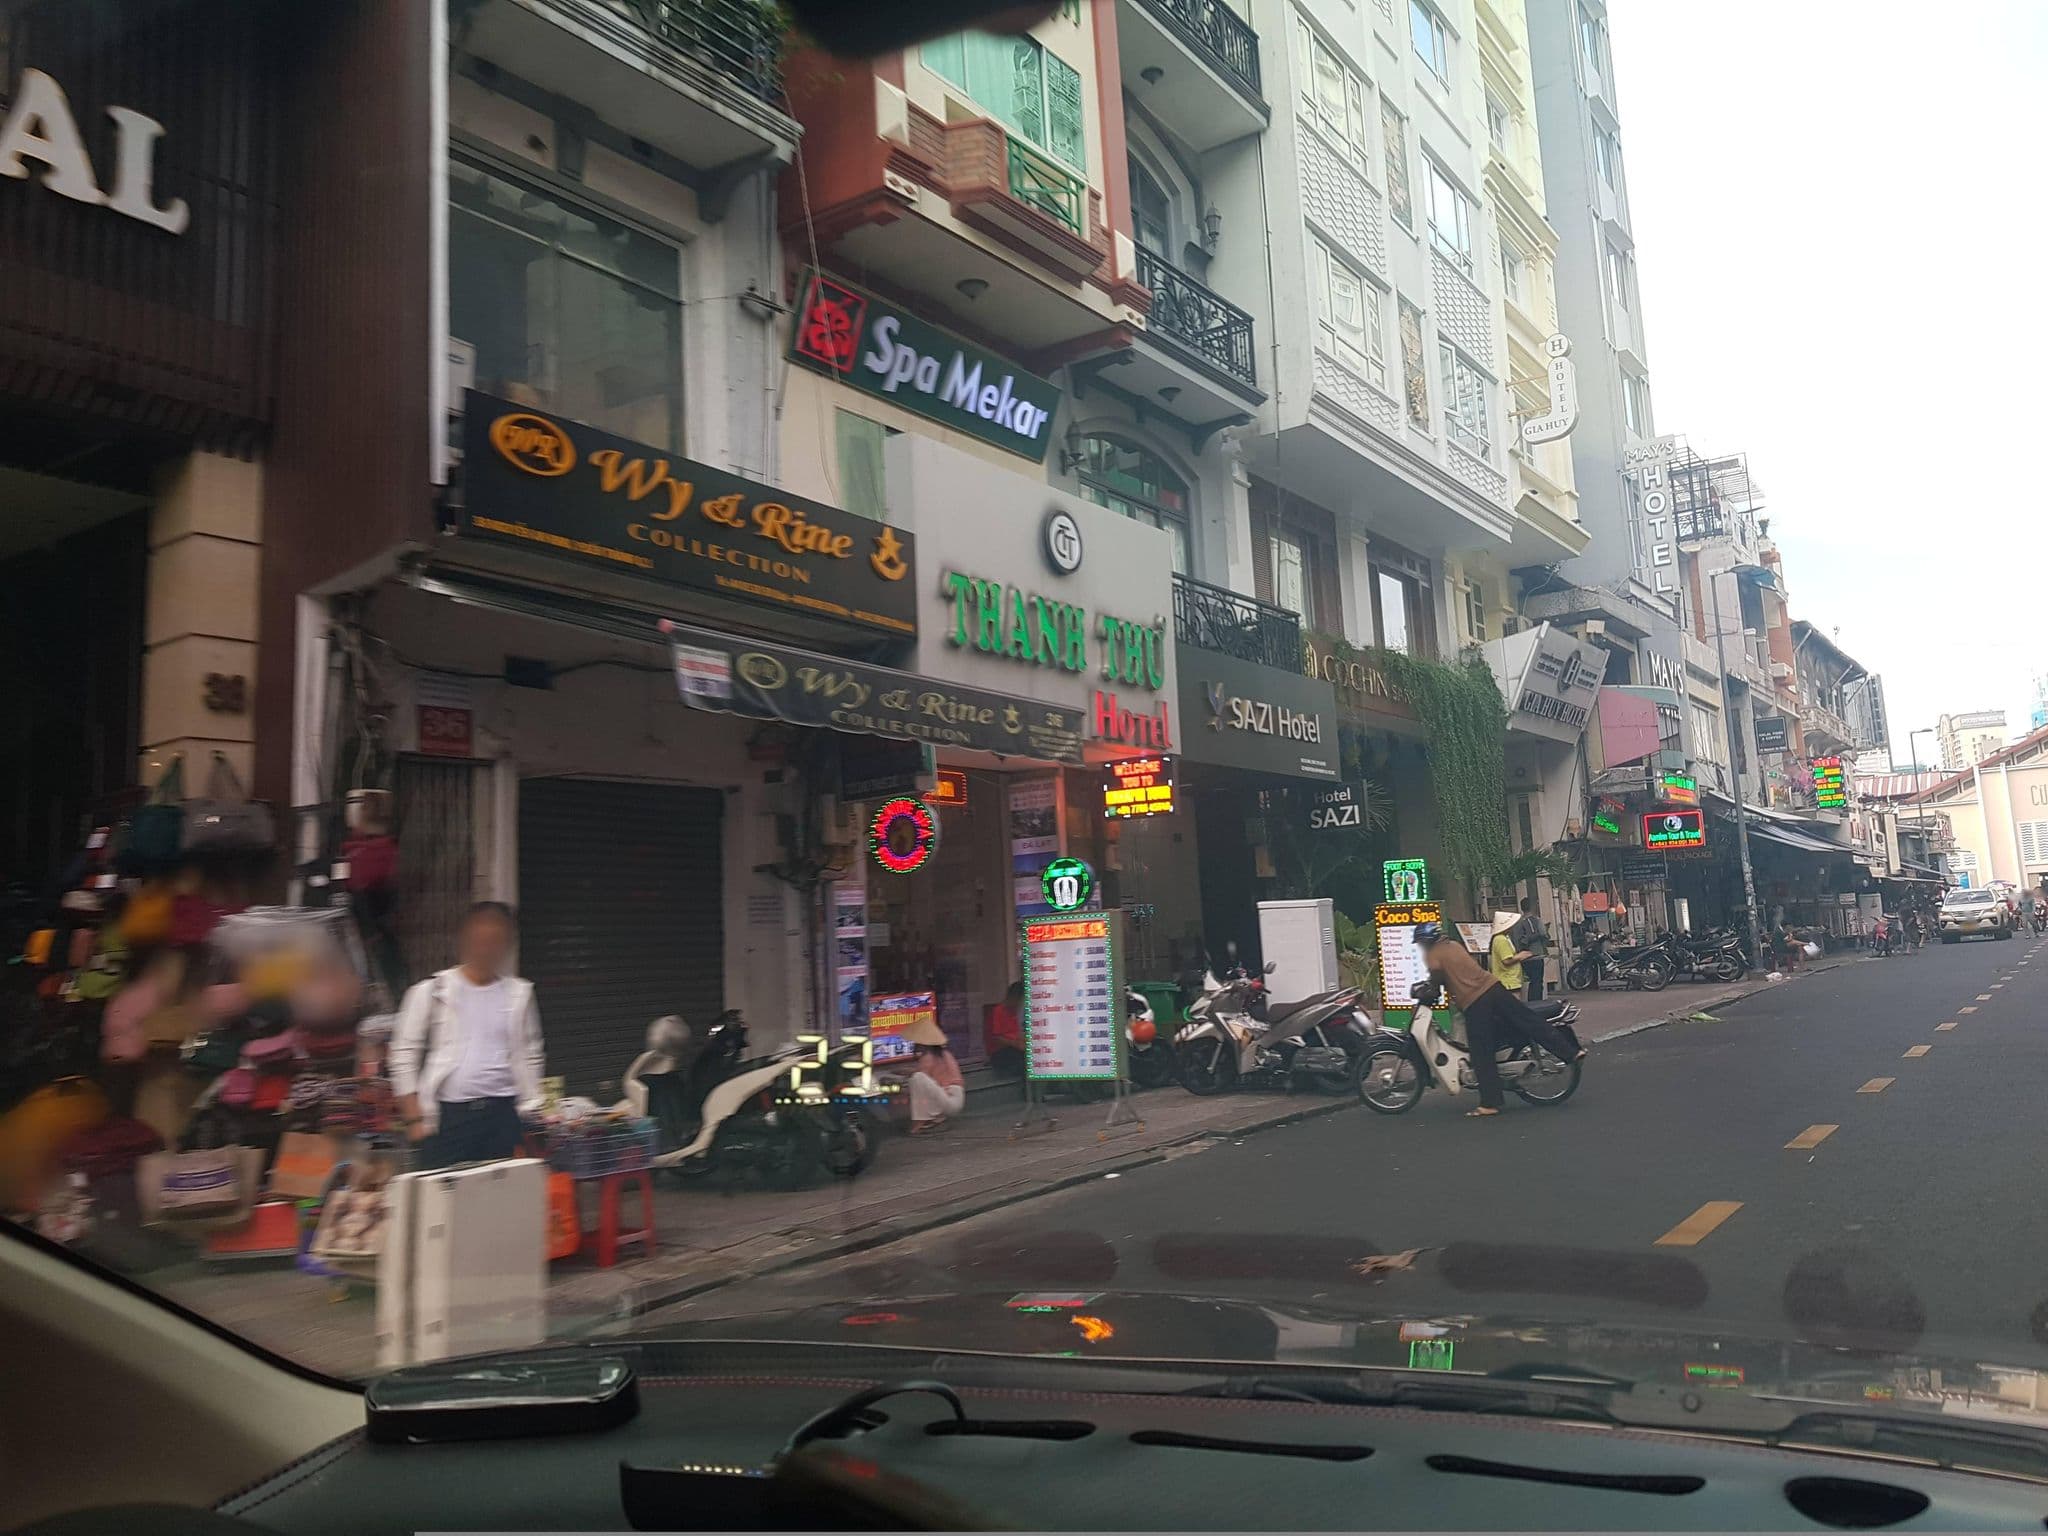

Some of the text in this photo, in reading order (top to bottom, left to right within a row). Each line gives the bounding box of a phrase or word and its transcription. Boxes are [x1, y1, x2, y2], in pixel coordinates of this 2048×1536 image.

[864, 316, 1049, 439] Spa Mekar
[1554, 361, 1568, 413] HOTEL
[1524, 417, 1570, 436] GIA HUY
[1624, 440, 1675, 464] MAY'S
[588, 449, 694, 521] Wy
[751, 502, 855, 559] Rine
[1642, 464, 1673, 592] HOTEL
[626, 522, 811, 584] COLLECTION
[946, 571, 1088, 672] THANH
[1649, 650, 1684, 695] MAY'S
[797, 667, 871, 710] Wy
[917, 693, 995, 726] Rine
[1524, 690, 1540, 714] GIA
[1541, 695, 1562, 720] HUY
[830, 709, 971, 744] COLLECTION
[1230, 697, 1321, 744] SAZI Hotel
[1310, 803, 1361, 830] SAZI
[1313, 787, 1352, 805] Hotel
[1378, 908, 1437, 924] Coco Spa
[791, 1035, 872, 1095] 23
